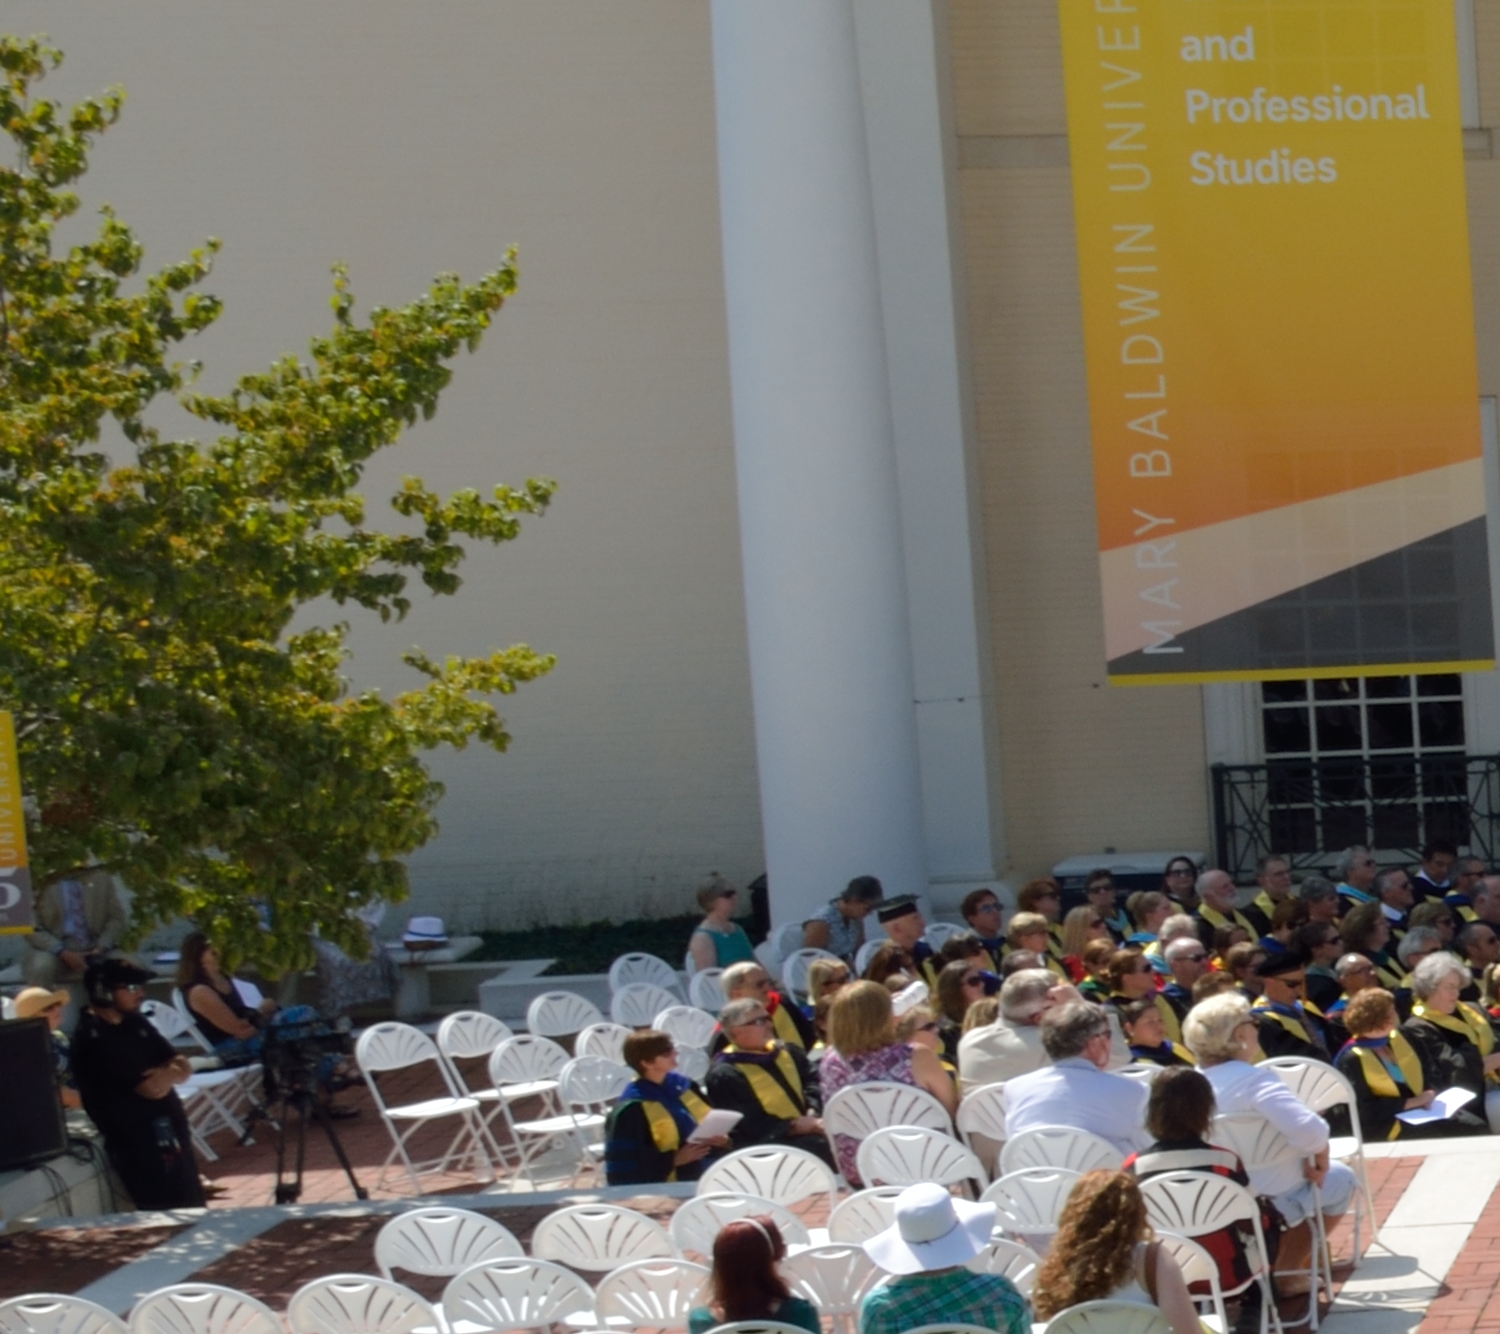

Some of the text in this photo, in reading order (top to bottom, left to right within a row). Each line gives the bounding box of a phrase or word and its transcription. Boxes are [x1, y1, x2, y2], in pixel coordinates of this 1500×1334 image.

[1180, 27, 1255, 63] and
[1184, 85, 1430, 124] Professional
[1189, 149, 1338, 186] Studies
[1112, 221, 1172, 480] BALDWIN
[1131, 508, 1184, 656] MARY
